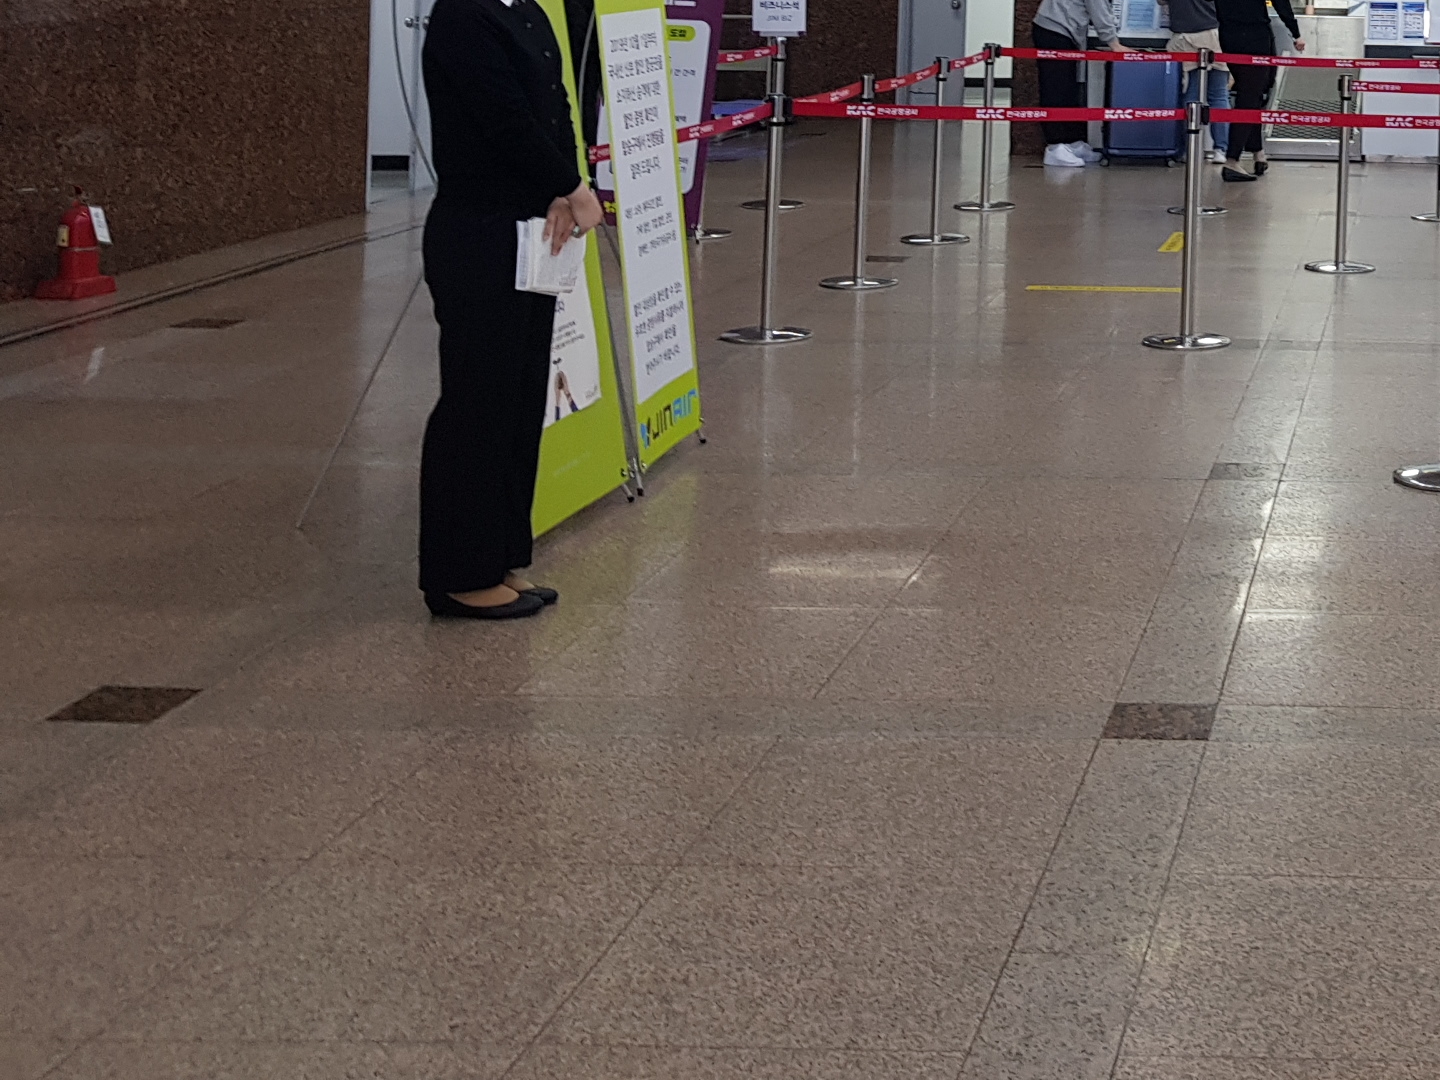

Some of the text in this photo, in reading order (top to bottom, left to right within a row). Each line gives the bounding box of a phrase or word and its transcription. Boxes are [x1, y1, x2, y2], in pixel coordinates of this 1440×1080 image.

[760, 0, 800, 10] 비즈니스석
[1037, 49, 1058, 59] KAC
[1124, 52, 1144, 61] KAC
[1252, 56, 1271, 65] KAC
[846, 105, 876, 116] KAC
[976, 108, 1005, 119] KAC
[1104, 109, 1133, 119] KAC
[1261, 112, 1289, 123] KAC
[1385, 116, 1414, 127] KAC
